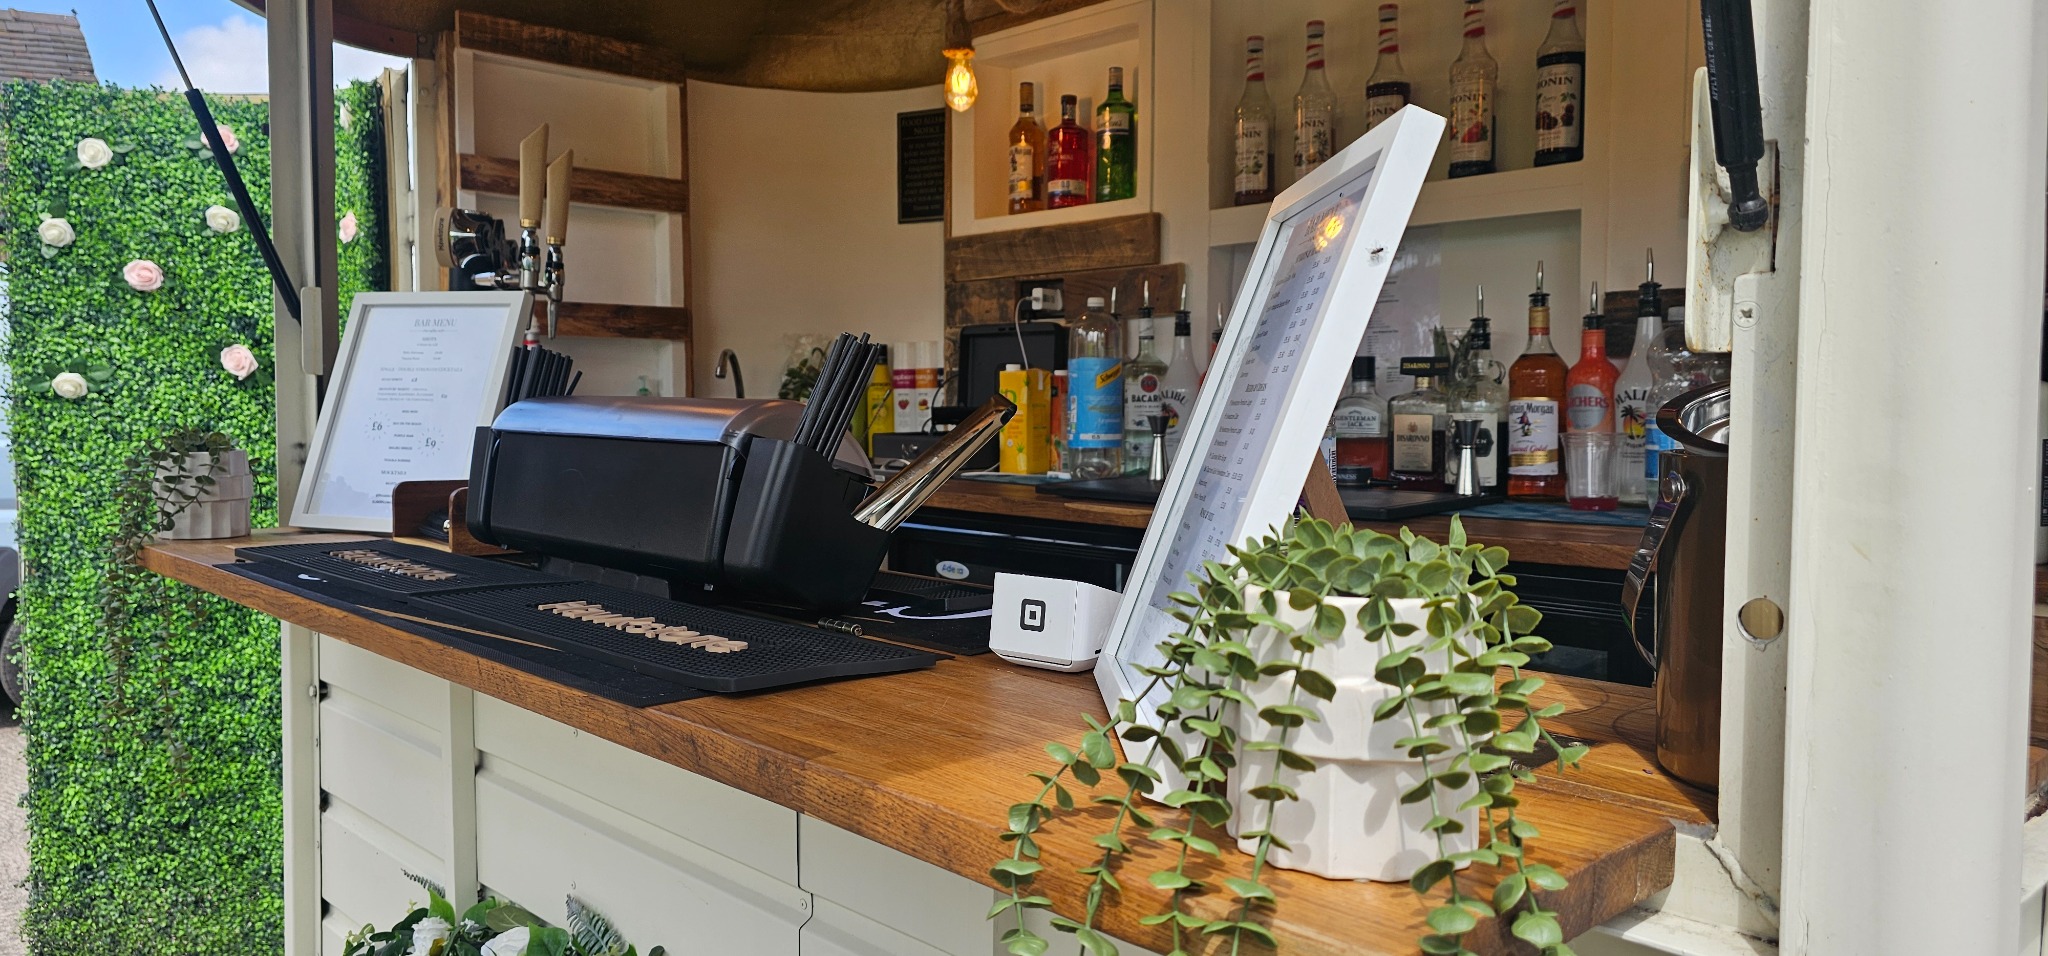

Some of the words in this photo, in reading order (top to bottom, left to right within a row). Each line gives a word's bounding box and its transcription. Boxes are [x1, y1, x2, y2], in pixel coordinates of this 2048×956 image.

[414, 318, 431, 327] BAR
[432, 317, 458, 327] MENU
[1131, 394, 1160, 403] BACAR
[1525, 402, 1555, 415] Morgan
[371, 421, 383, 431] £6
[425, 437, 437, 448] £9
